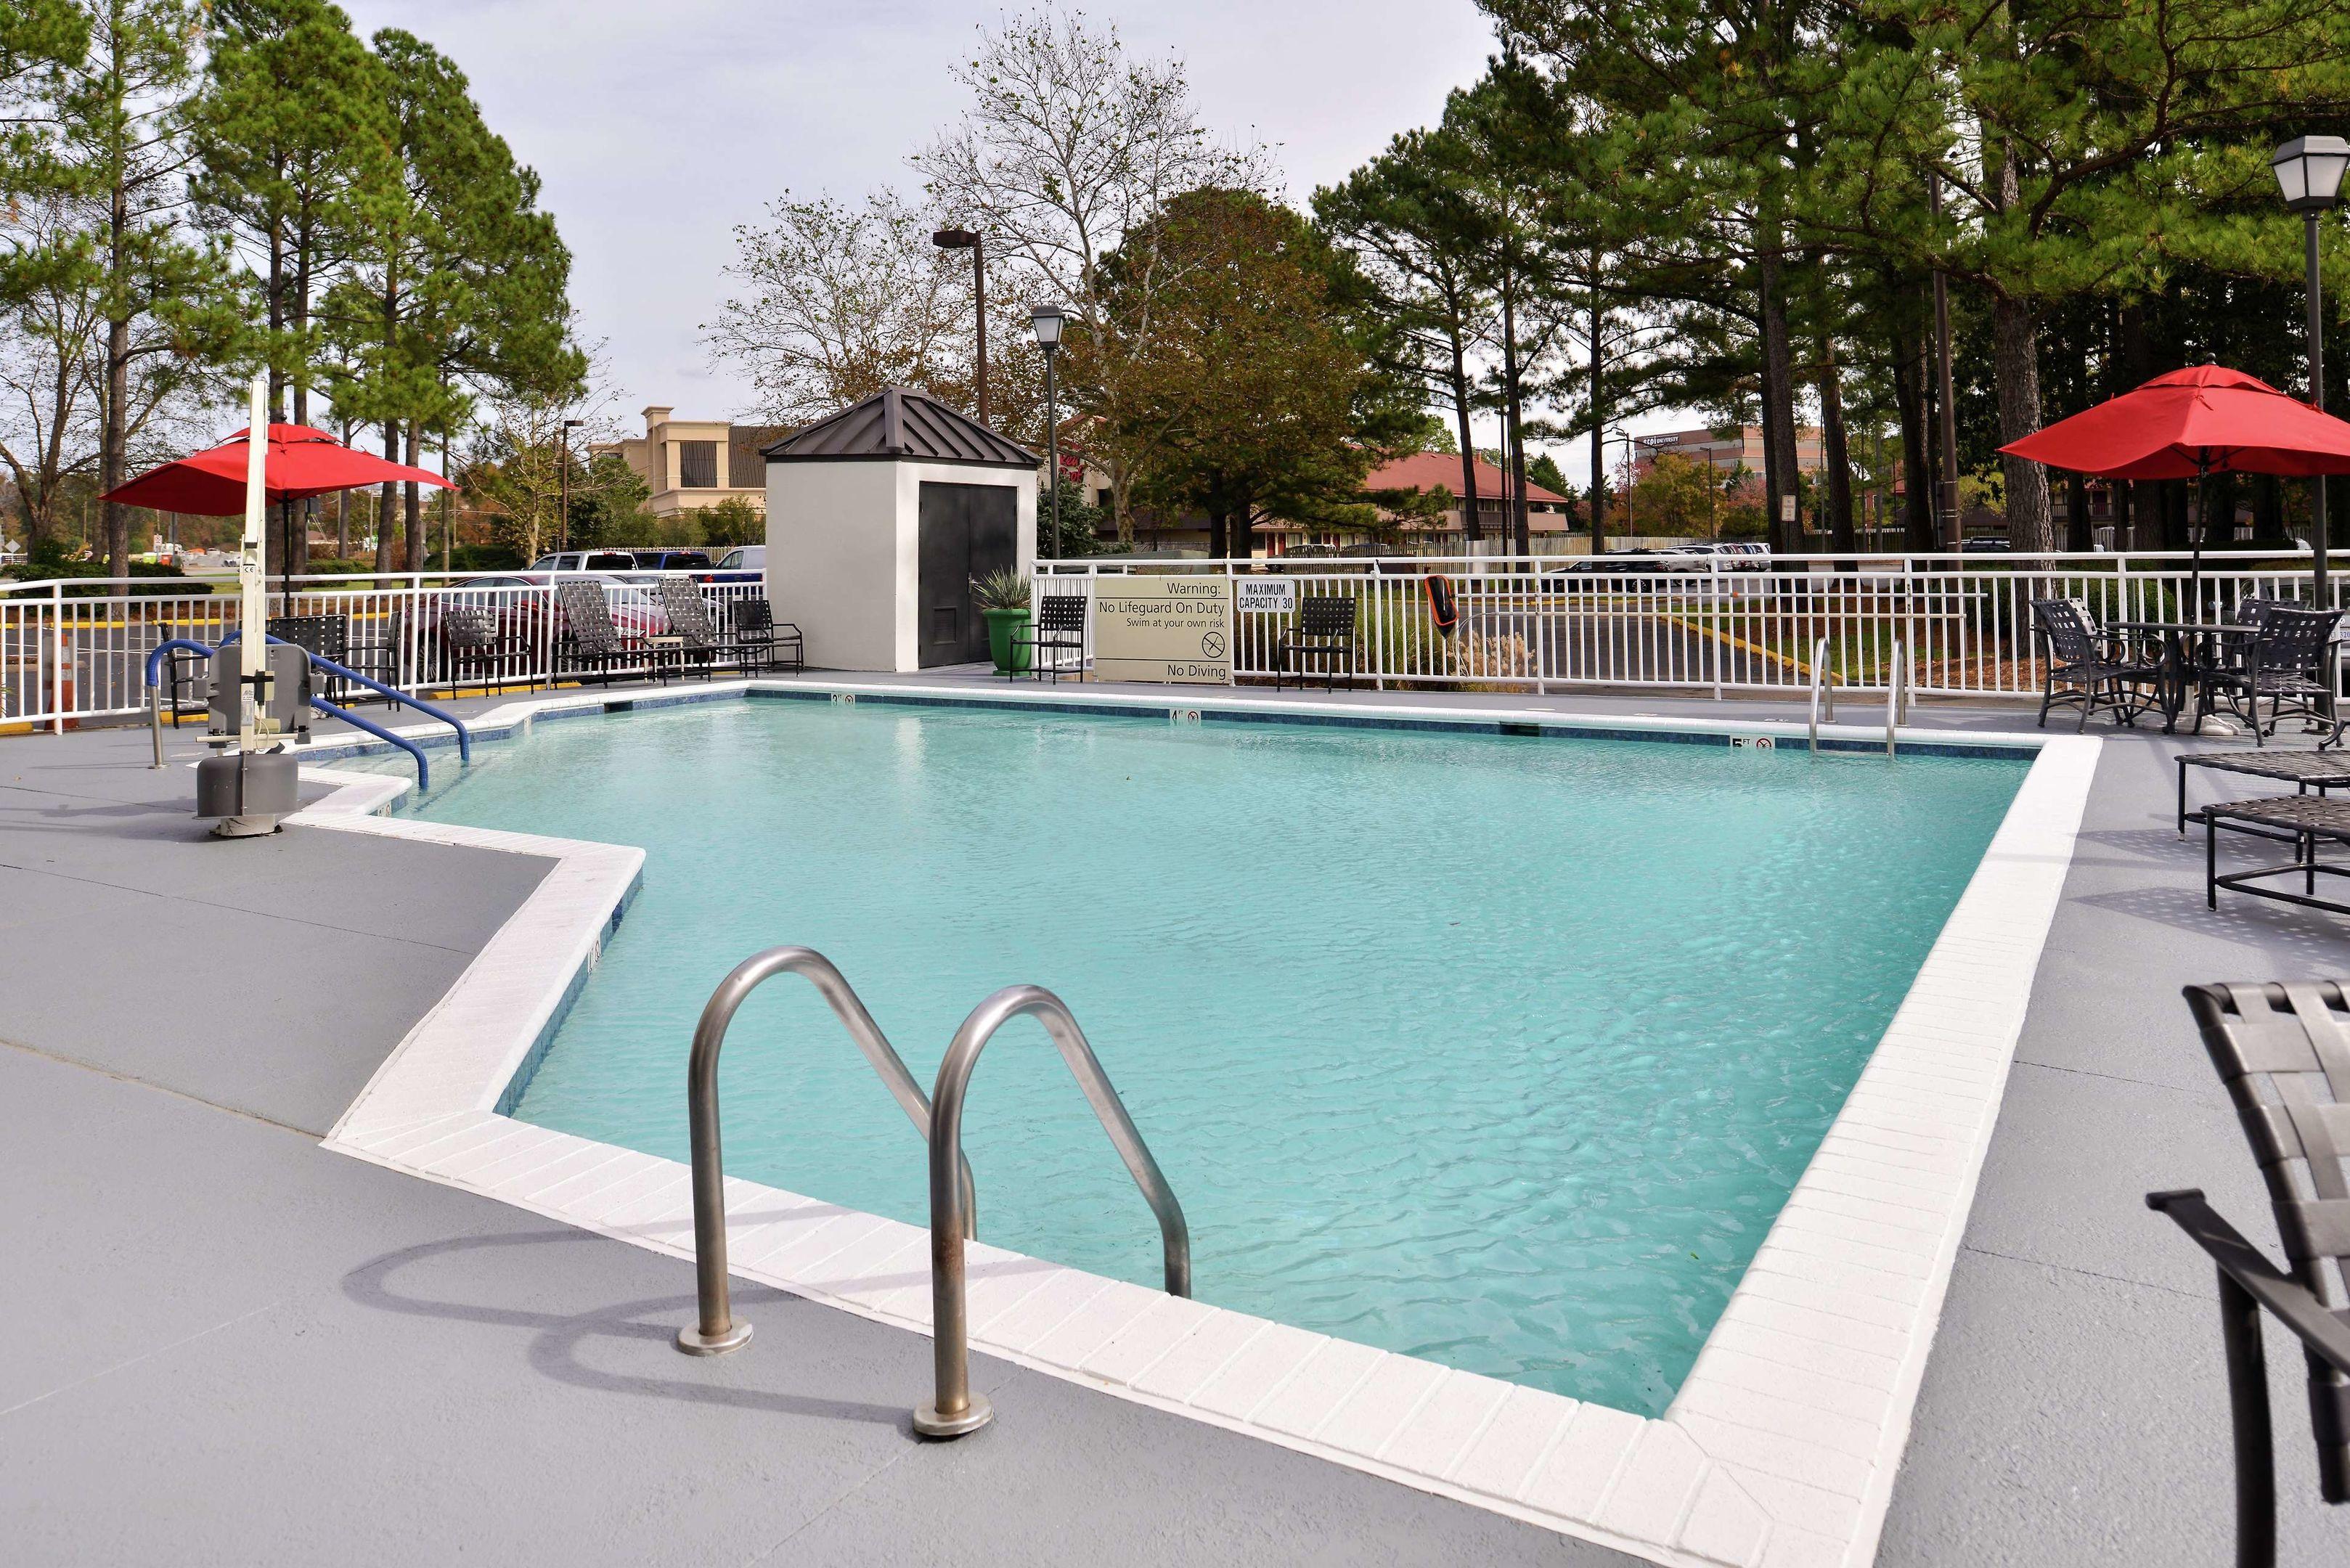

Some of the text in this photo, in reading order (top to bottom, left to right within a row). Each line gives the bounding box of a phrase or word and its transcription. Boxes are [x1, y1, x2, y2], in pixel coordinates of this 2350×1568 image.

[1167, 582, 1221, 597] Warning:
[1246, 583, 1286, 595] MAXIMUM
[1099, 601, 1225, 616] No Lifeguard On Duty
[1239, 597, 1293, 609] CAPACITY 30
[1127, 617, 1150, 627] Swim
[1153, 618, 1162, 627] at
[1164, 619, 1184, 629] your
[1209, 618, 1225, 628] risk
[1167, 664, 1226, 680] No Diving
